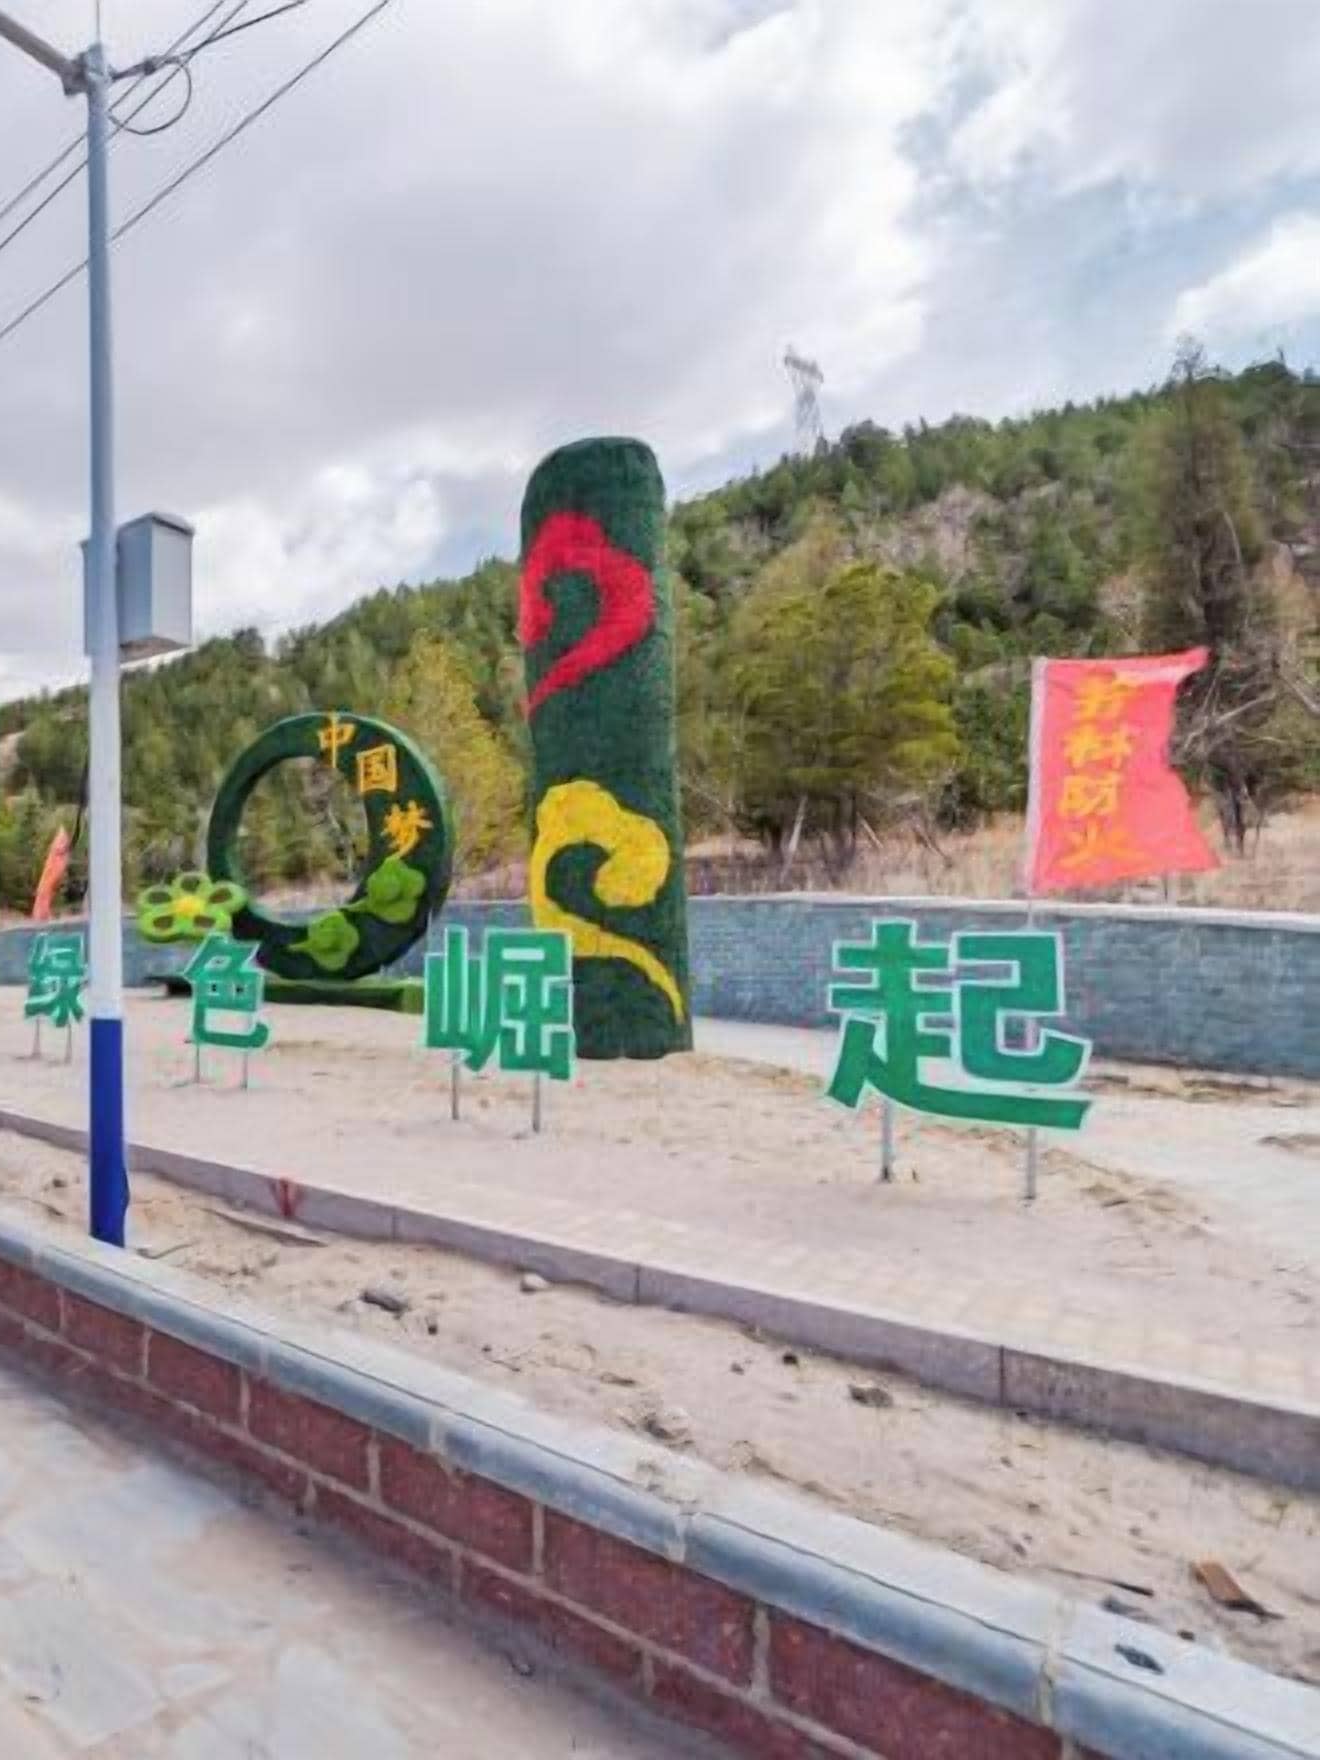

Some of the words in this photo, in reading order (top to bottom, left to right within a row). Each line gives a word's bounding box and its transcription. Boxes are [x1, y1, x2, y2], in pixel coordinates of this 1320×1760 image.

[317, 711, 433, 859] 中国梦
[23, 920, 1094, 1132] 绿色崛起
